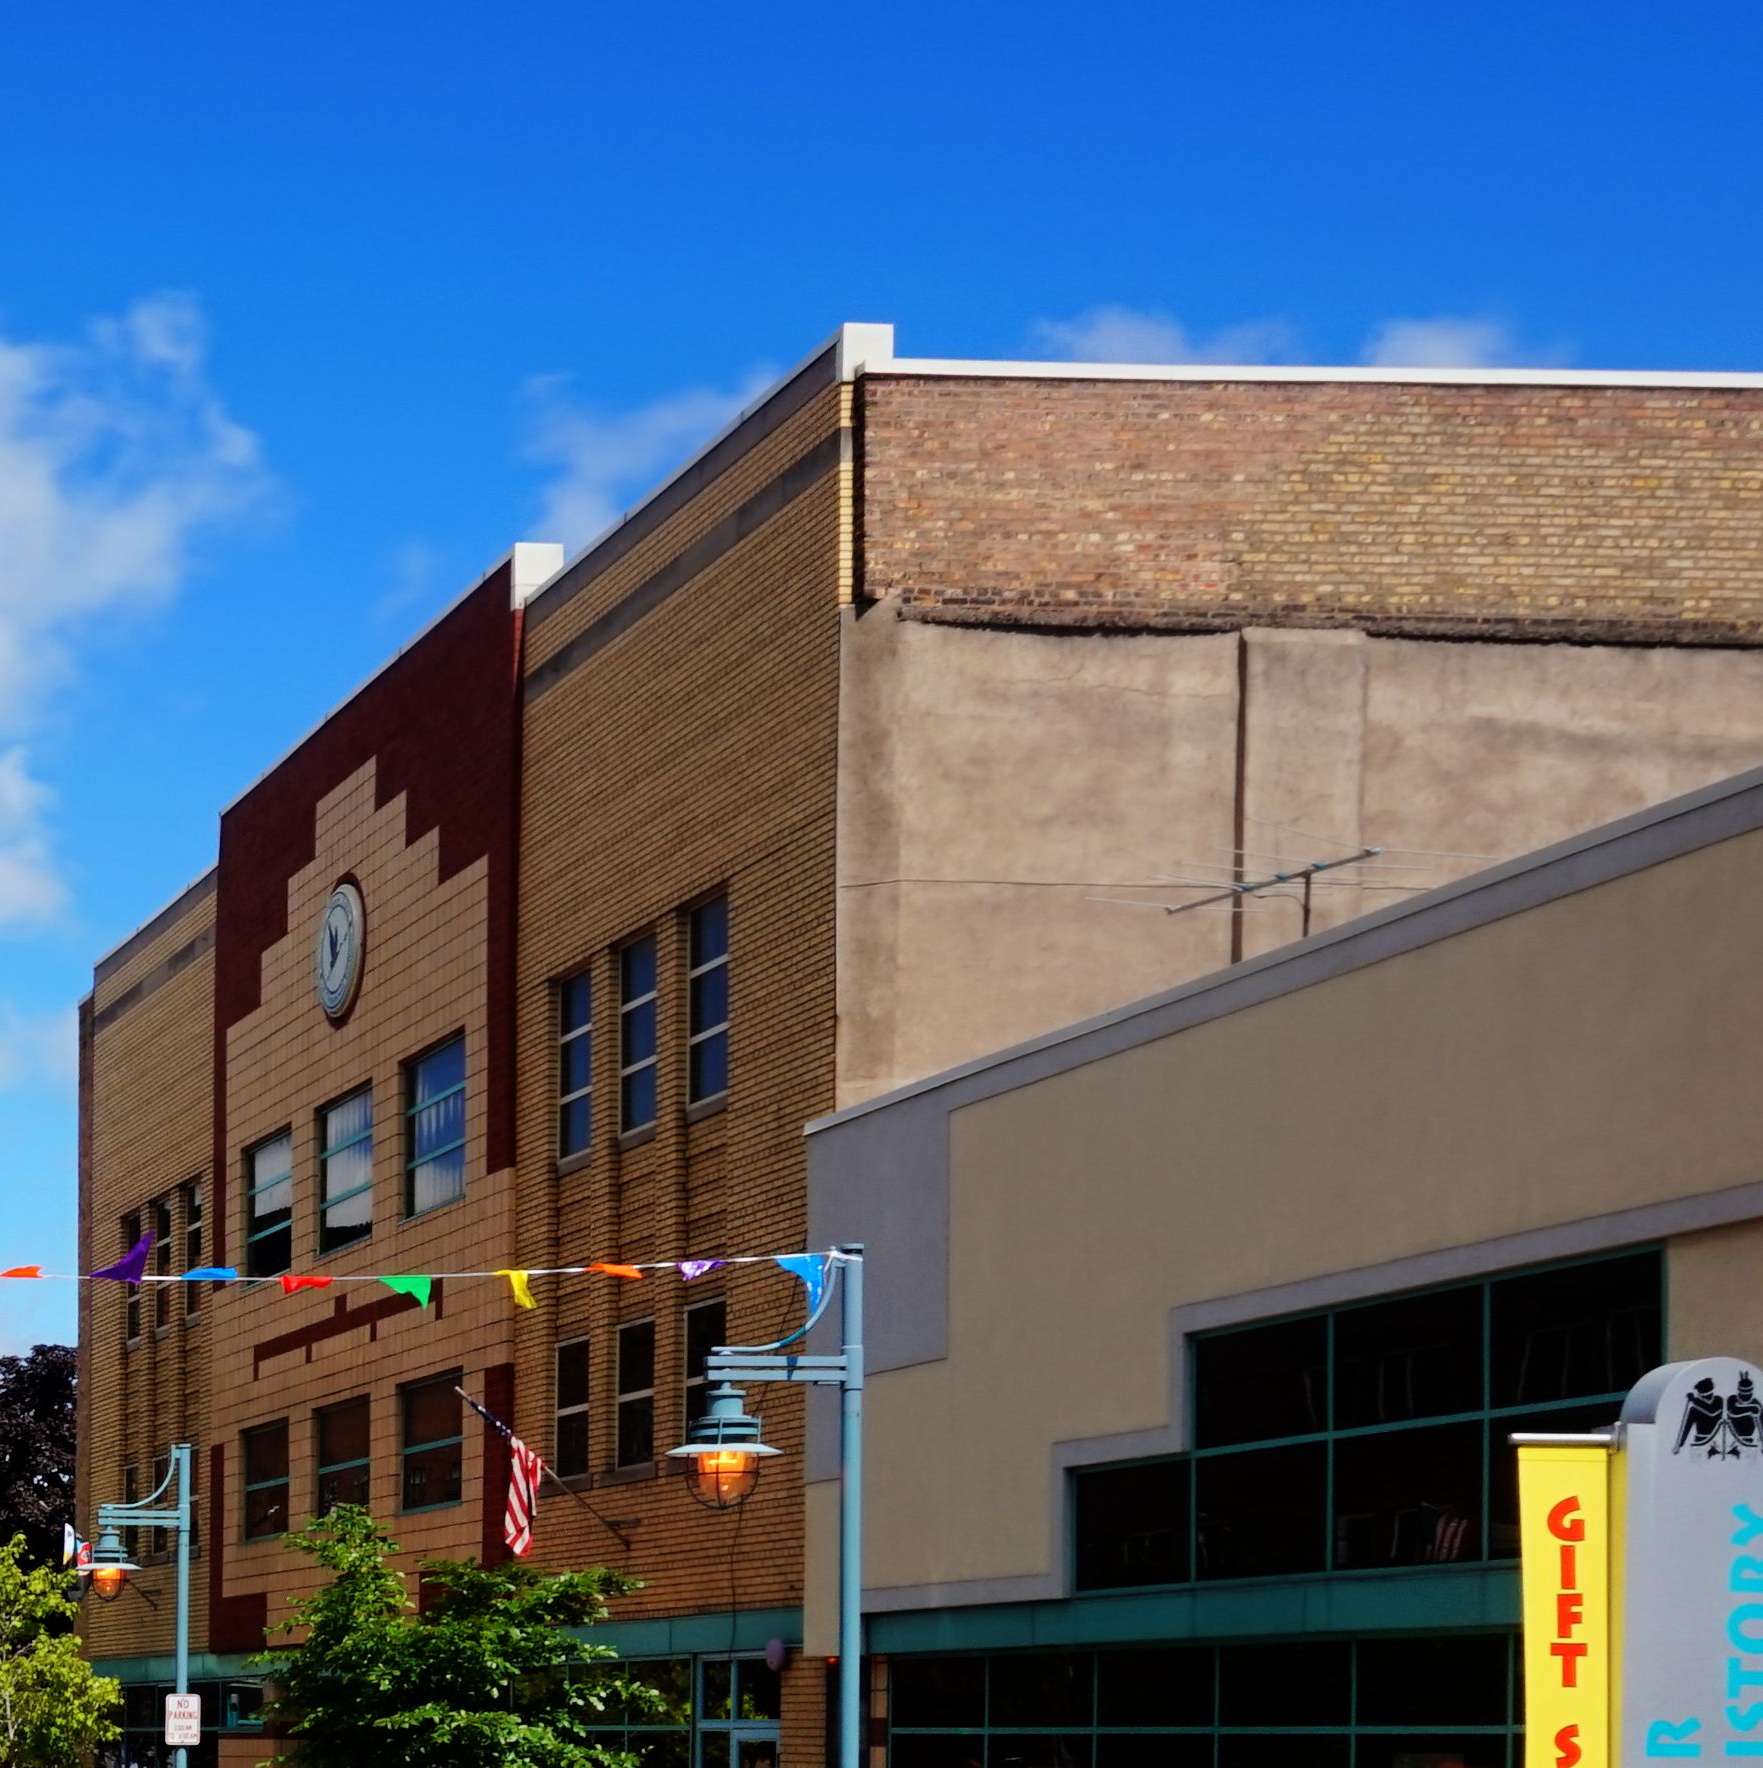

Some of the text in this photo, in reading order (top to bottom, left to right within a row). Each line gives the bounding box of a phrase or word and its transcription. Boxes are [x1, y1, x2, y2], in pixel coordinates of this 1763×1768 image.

[1547, 1495, 1589, 1688] GIFT
[177, 1700, 190, 1709] NO
[167, 1711, 199, 1720] PARKING
